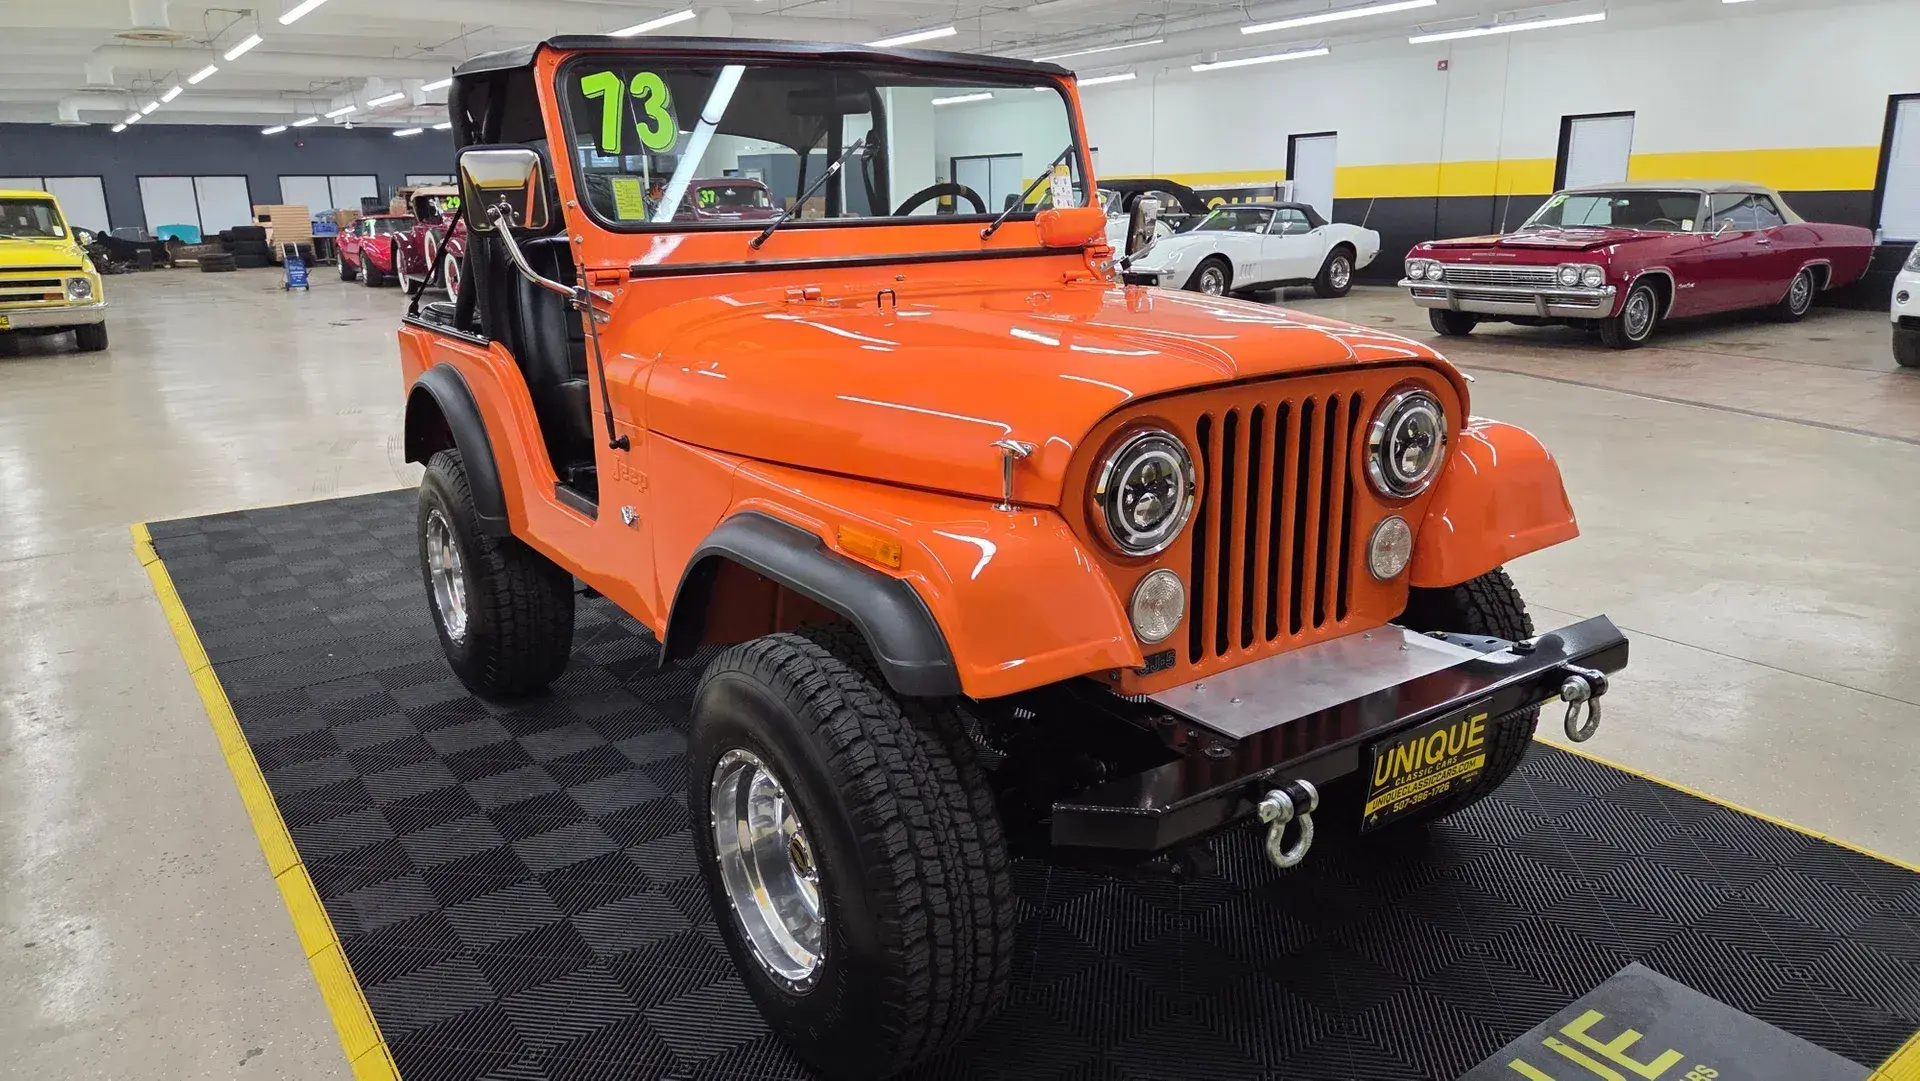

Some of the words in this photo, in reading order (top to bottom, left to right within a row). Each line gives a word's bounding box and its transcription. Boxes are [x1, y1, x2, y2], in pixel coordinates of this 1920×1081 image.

[581, 71, 679, 155] 73
[612, 454, 648, 493] Jeep
[1374, 712, 1488, 787] UNIQUE
[1395, 767, 1433, 786] CLASSIC
[1436, 756, 1458, 770] CARS
[1372, 758, 1477, 810] UNIQUECLASSICCARS.COM
[1393, 781, 1451, 813] 507-386-1726
